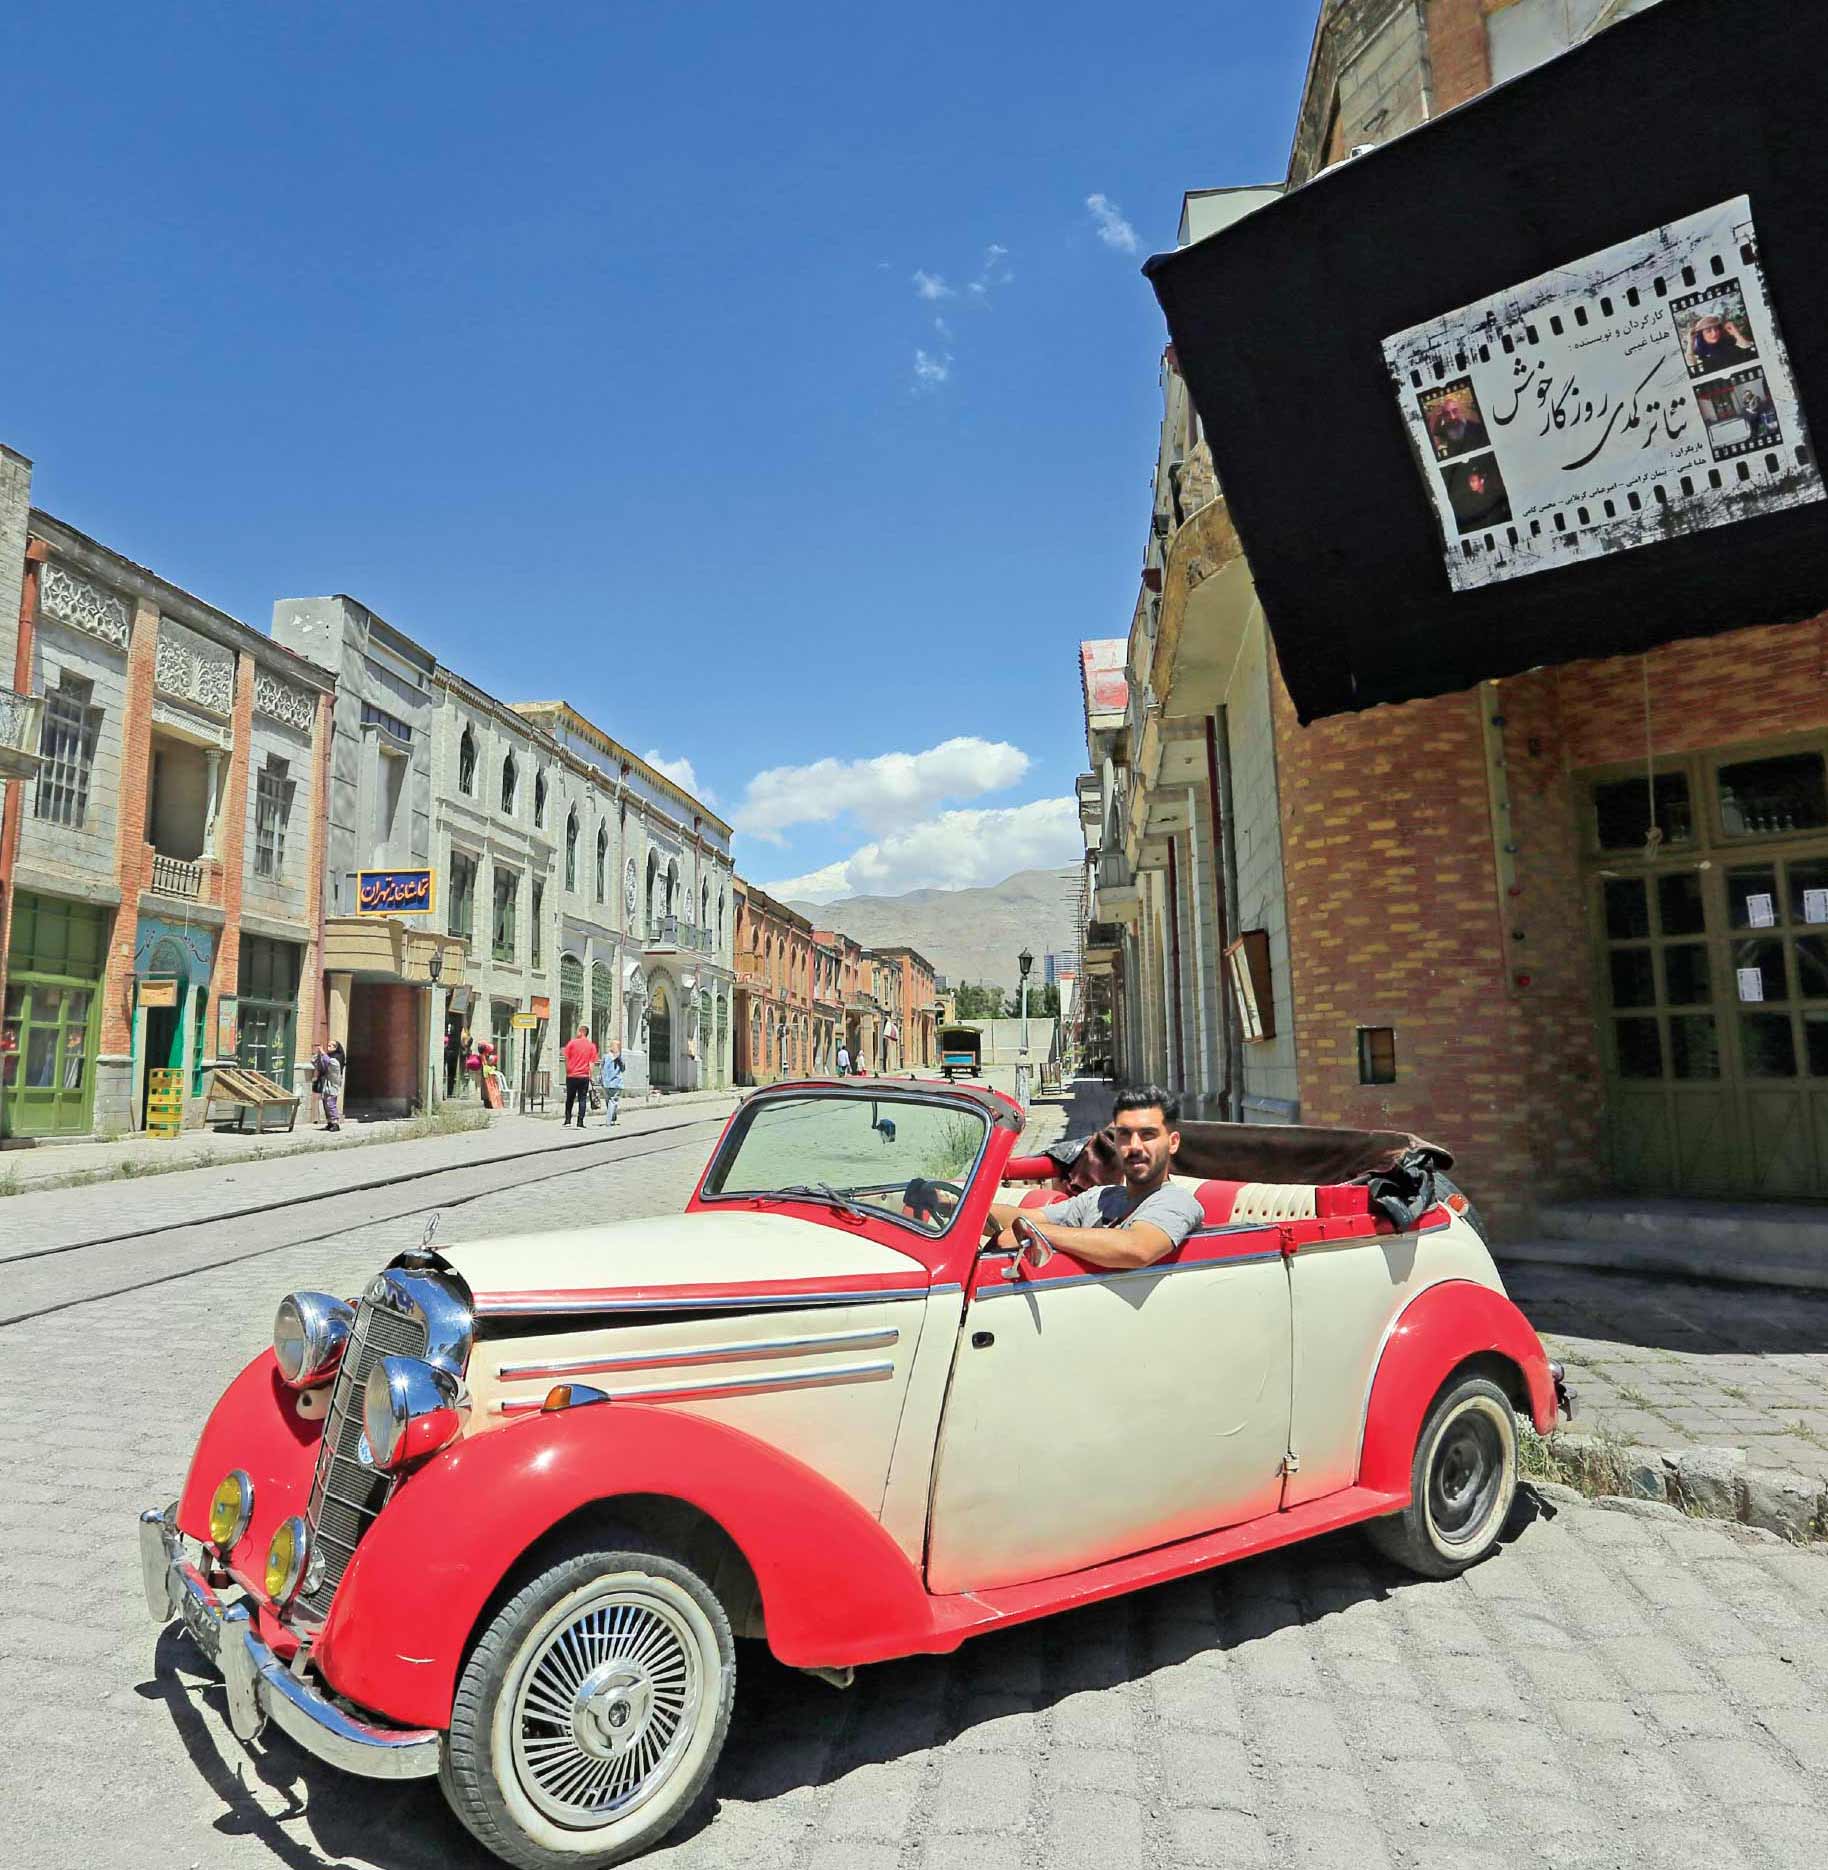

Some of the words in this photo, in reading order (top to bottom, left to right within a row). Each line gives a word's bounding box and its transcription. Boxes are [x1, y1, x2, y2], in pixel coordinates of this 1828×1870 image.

[1623, 309, 1663, 335] کارگردان
[1624, 336, 1648, 356] غیبی
[1650, 331, 1670, 344] هلیا
[1492, 358, 1553, 426] خوش
[1539, 375, 1608, 437] روزگار
[1561, 355, 1666, 471] کمدی
[1641, 397, 1687, 449] تئاتر
[361, 877, 392, 905] تهران
[387, 878, 430, 902] تماشاخانه
